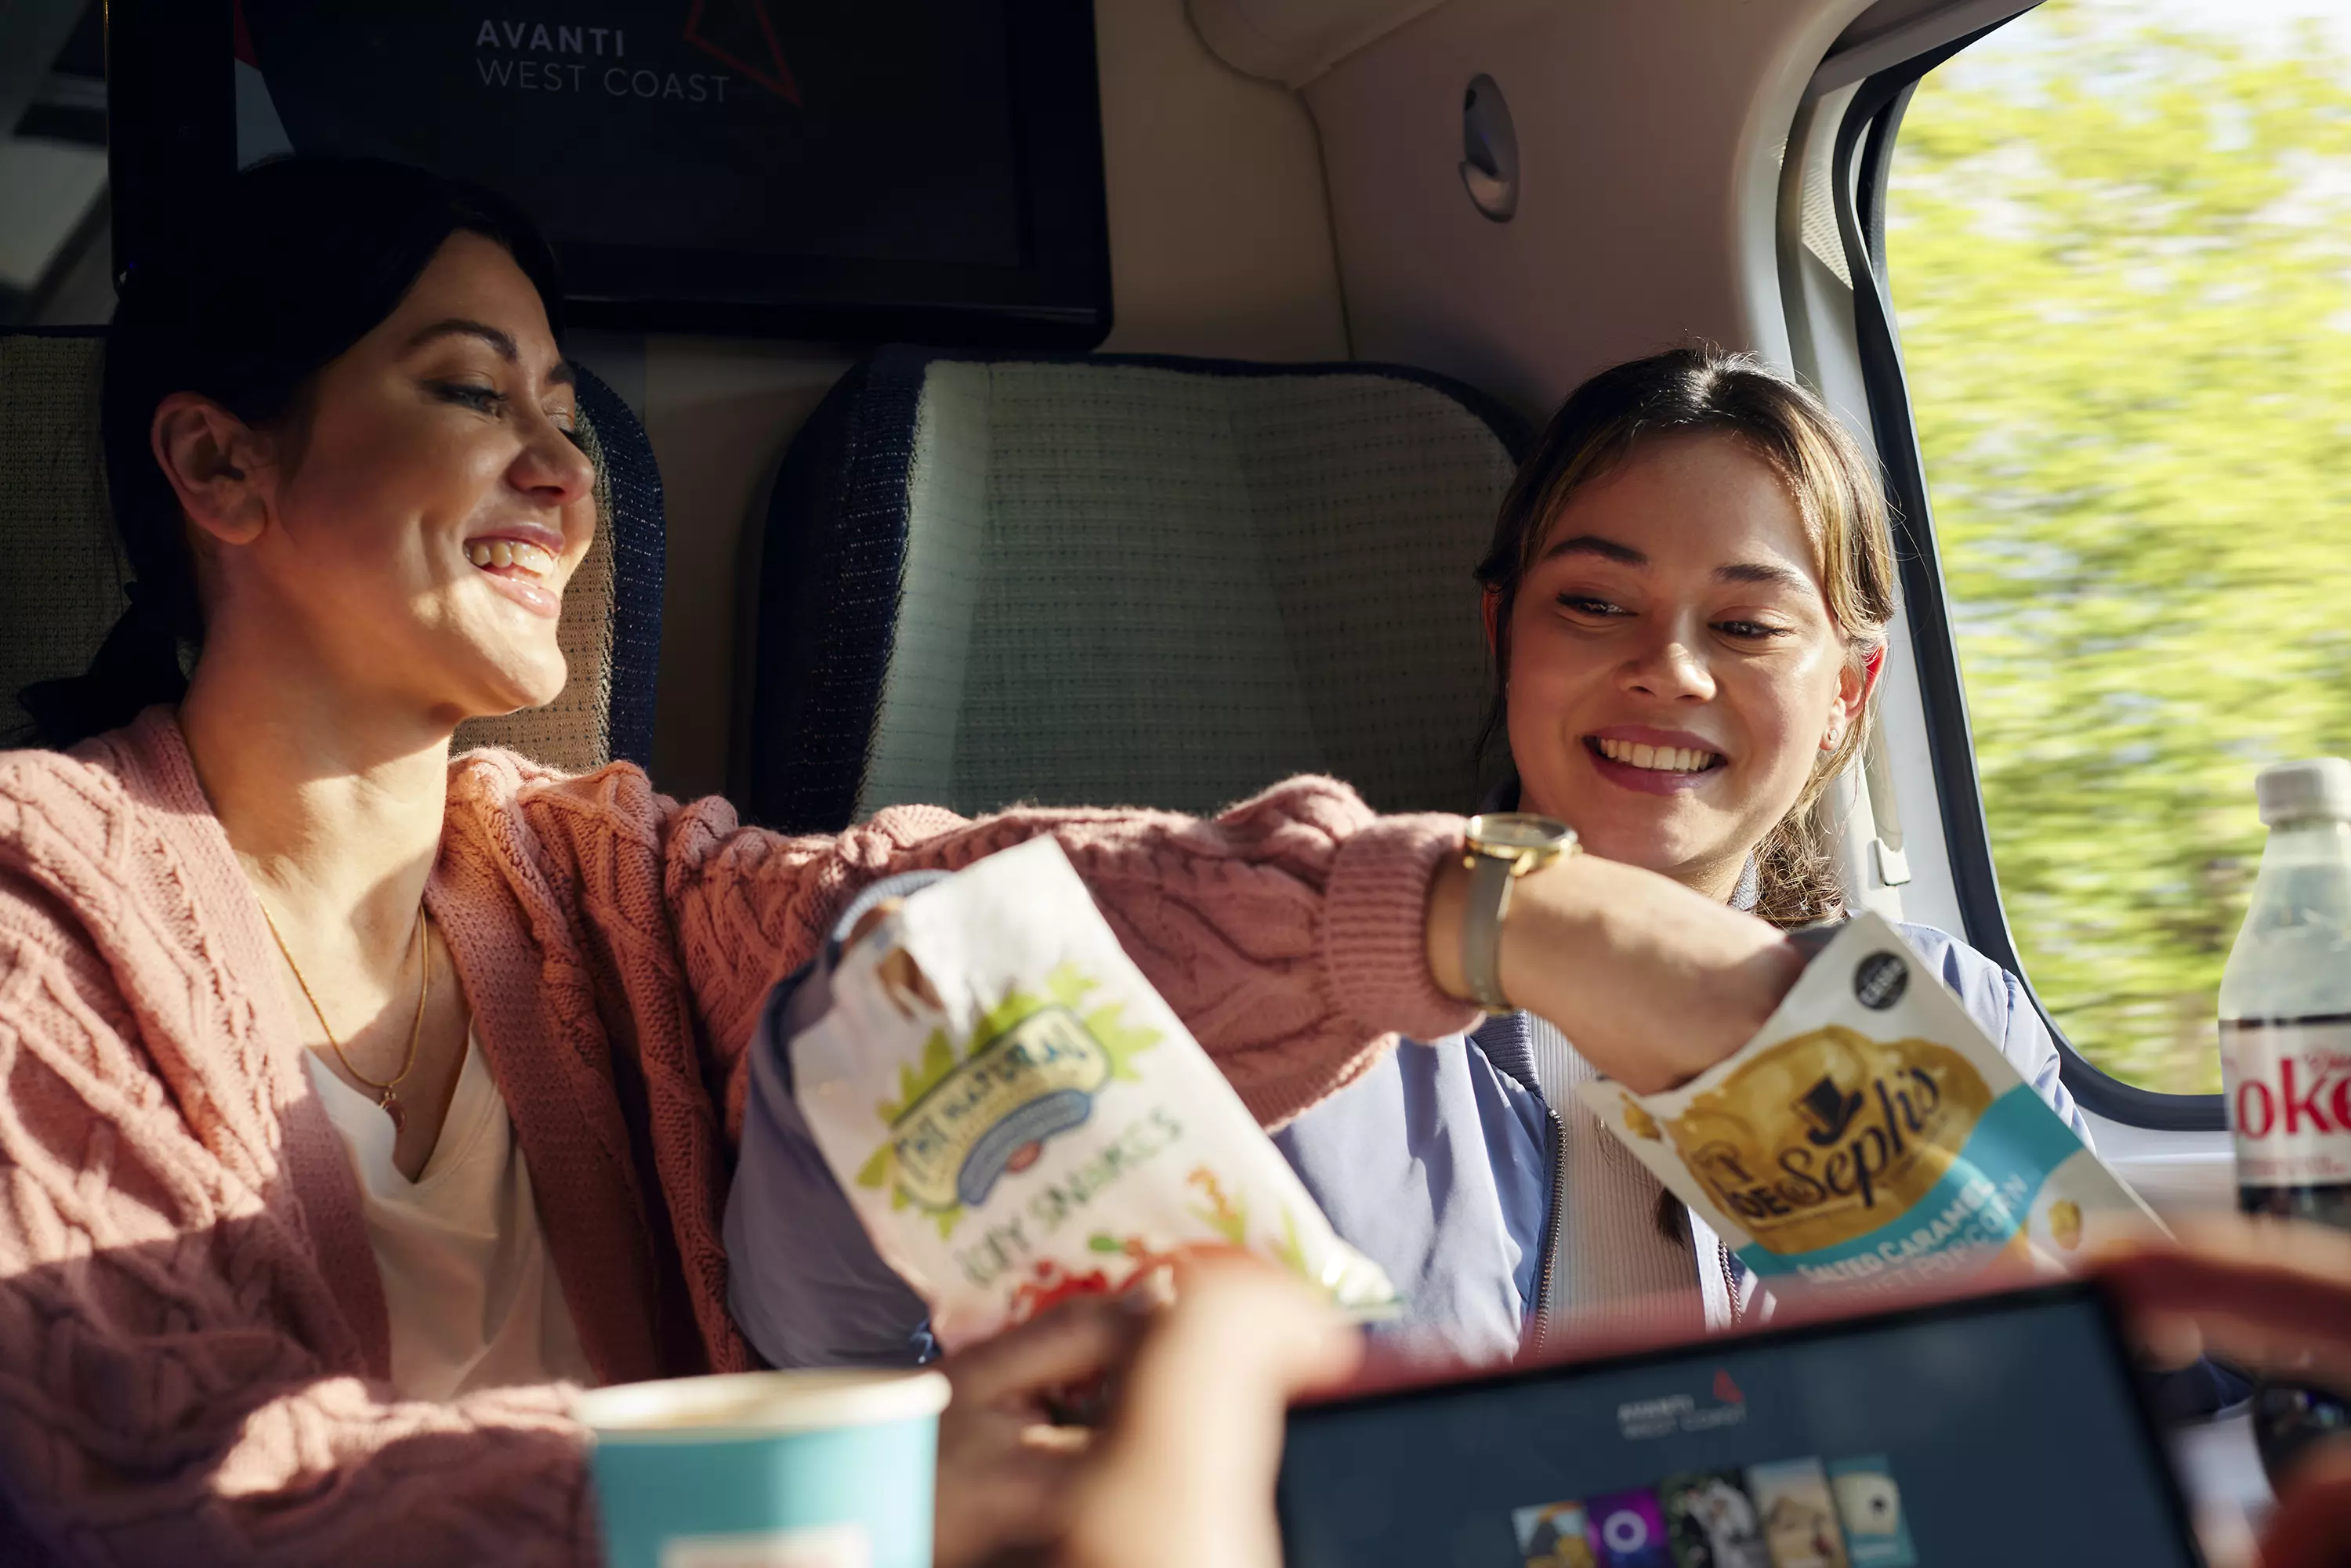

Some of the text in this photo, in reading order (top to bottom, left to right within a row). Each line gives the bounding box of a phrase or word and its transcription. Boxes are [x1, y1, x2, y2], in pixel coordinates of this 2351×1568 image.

[476, 20, 624, 57] AVANTI
[476, 58, 730, 103] WEST COAST
[1876, 1178, 1997, 1263] CARAMEL
